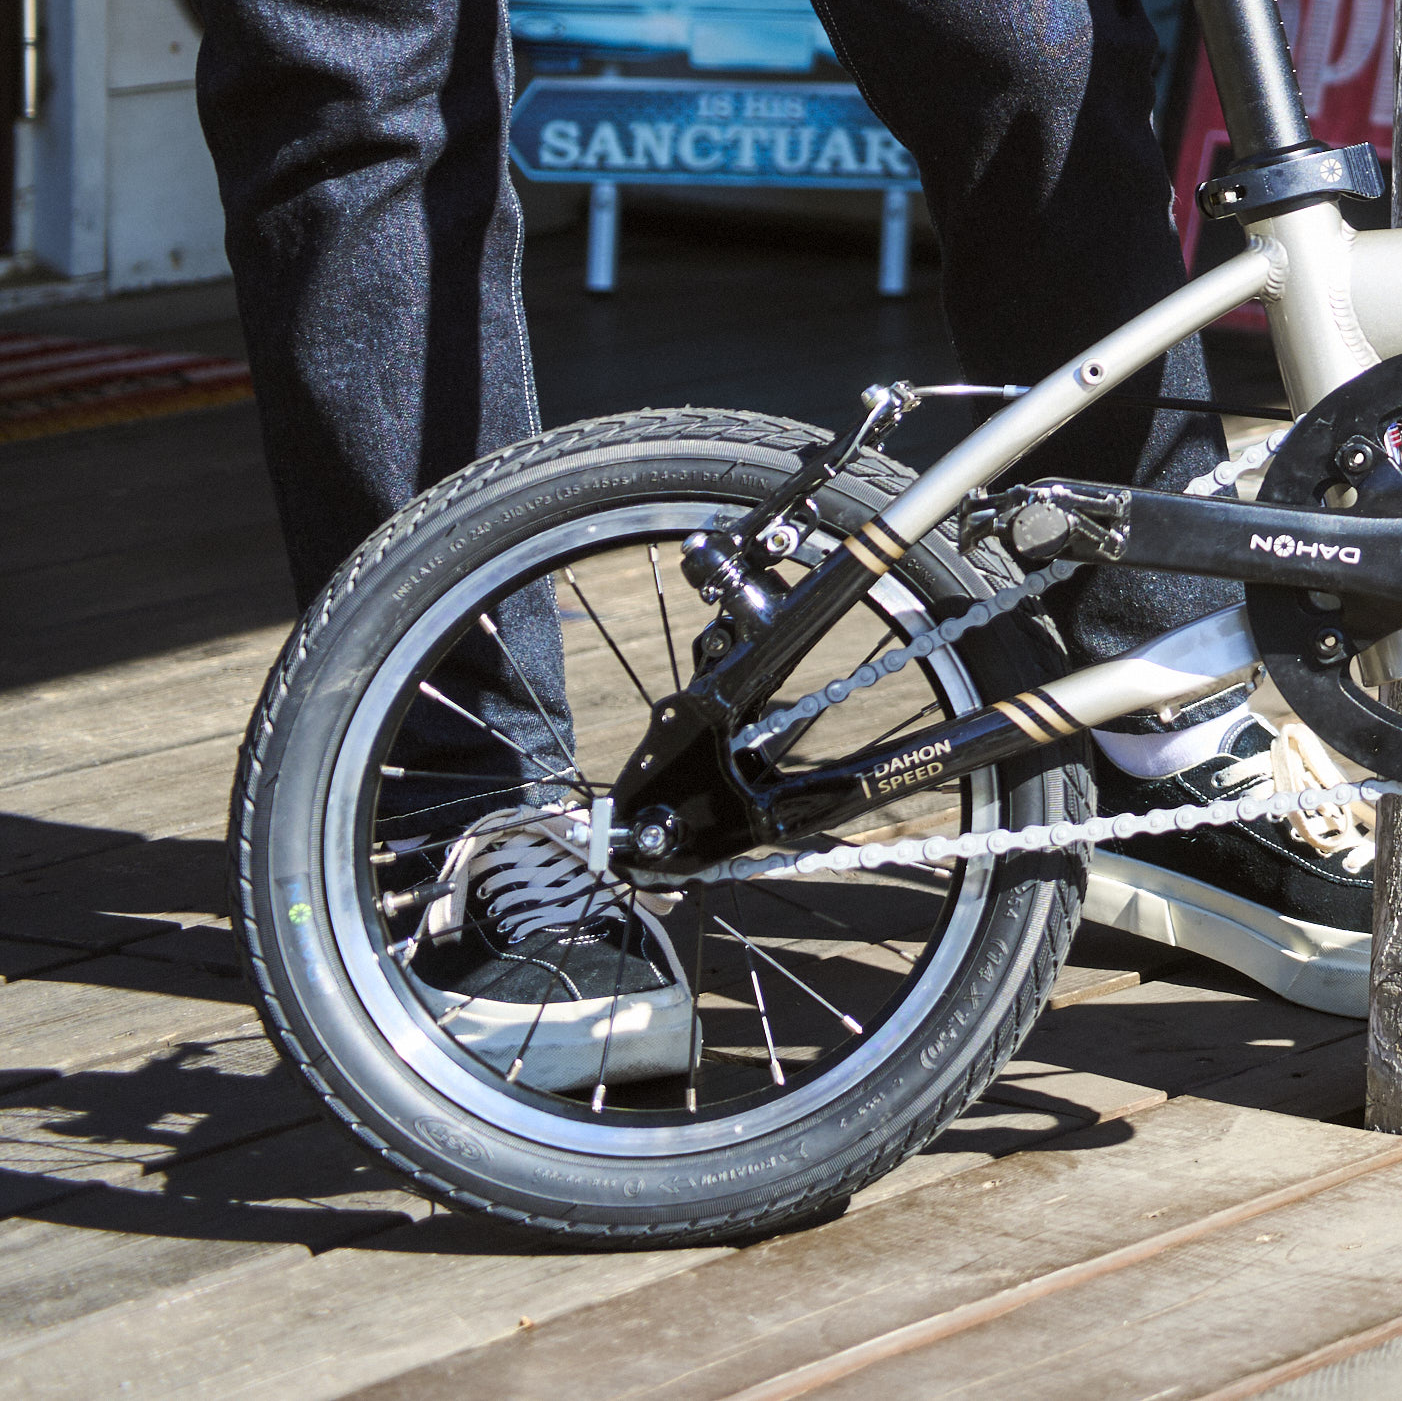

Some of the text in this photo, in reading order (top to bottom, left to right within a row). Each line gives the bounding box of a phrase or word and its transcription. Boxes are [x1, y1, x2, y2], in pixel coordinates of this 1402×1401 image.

[539, 119, 912, 175] SANCTUAR
[1250, 532, 1361, 565] DAHON
[873, 738, 953, 779] DAHON
[877, 761, 945, 796] SPEED
